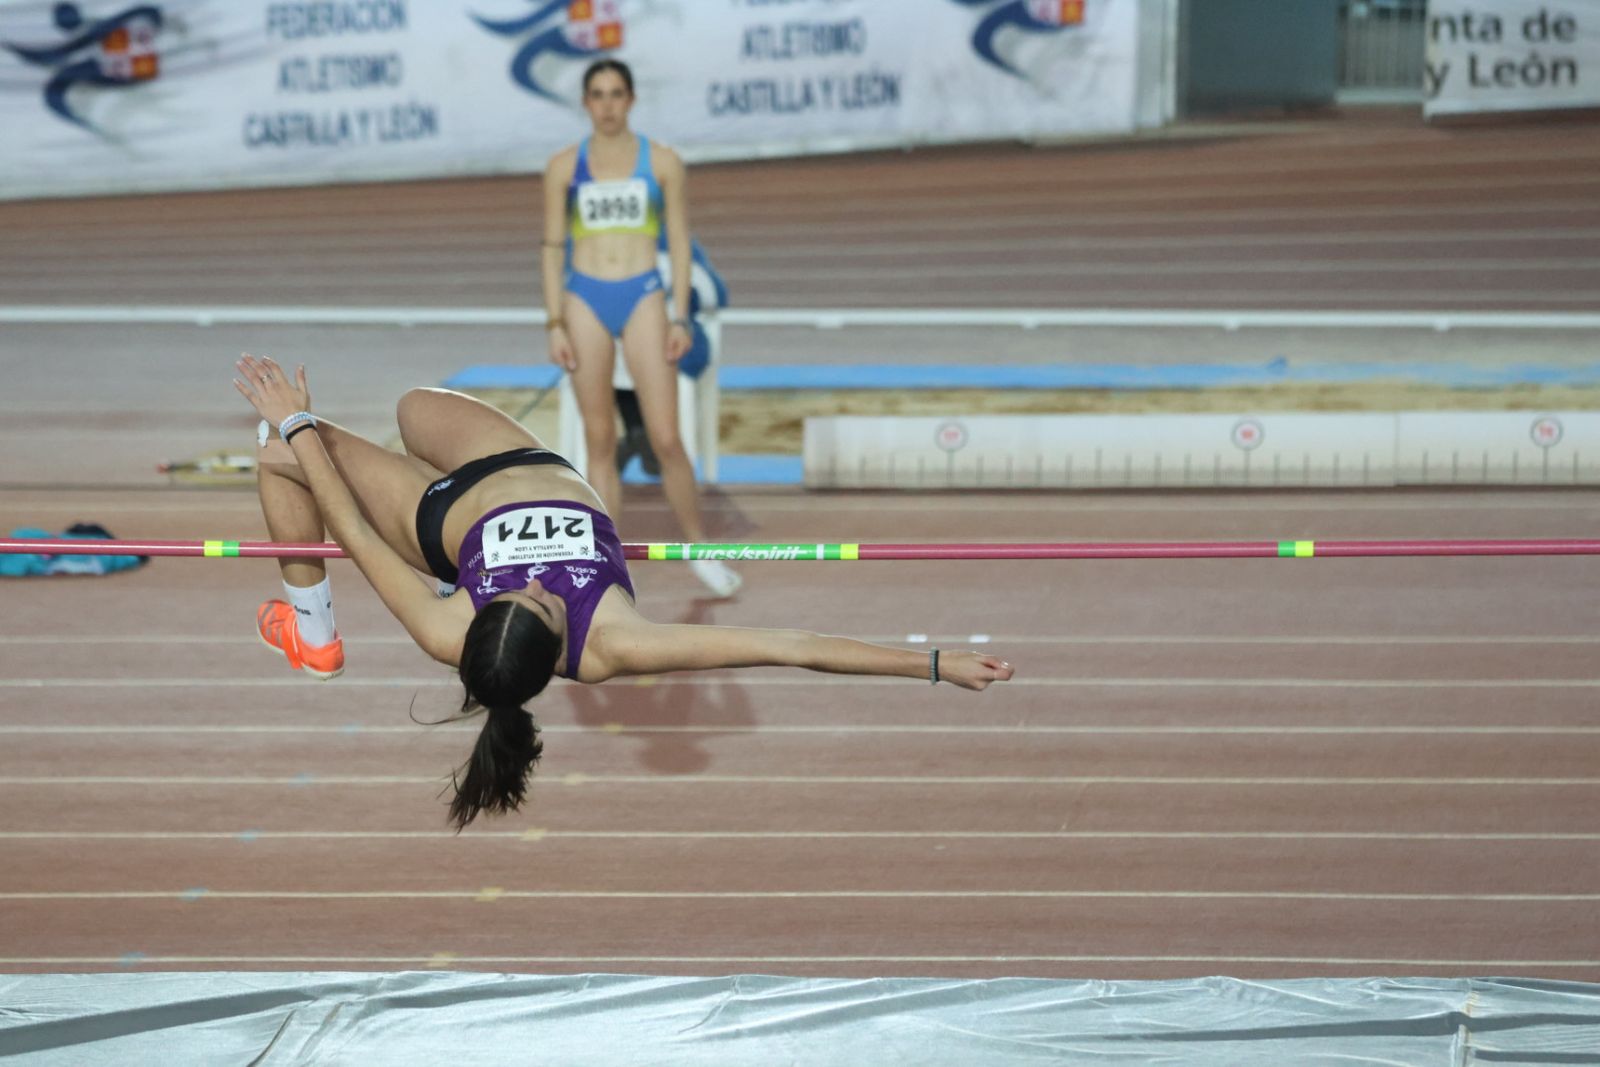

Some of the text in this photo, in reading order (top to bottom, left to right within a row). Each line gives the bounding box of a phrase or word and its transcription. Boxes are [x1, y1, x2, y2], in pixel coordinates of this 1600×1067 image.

[1522, 8, 1577, 42] de
[1425, 51, 1578, 97] y León
[587, 195, 641, 221] 2898
[496, 515, 586, 542] 2171
